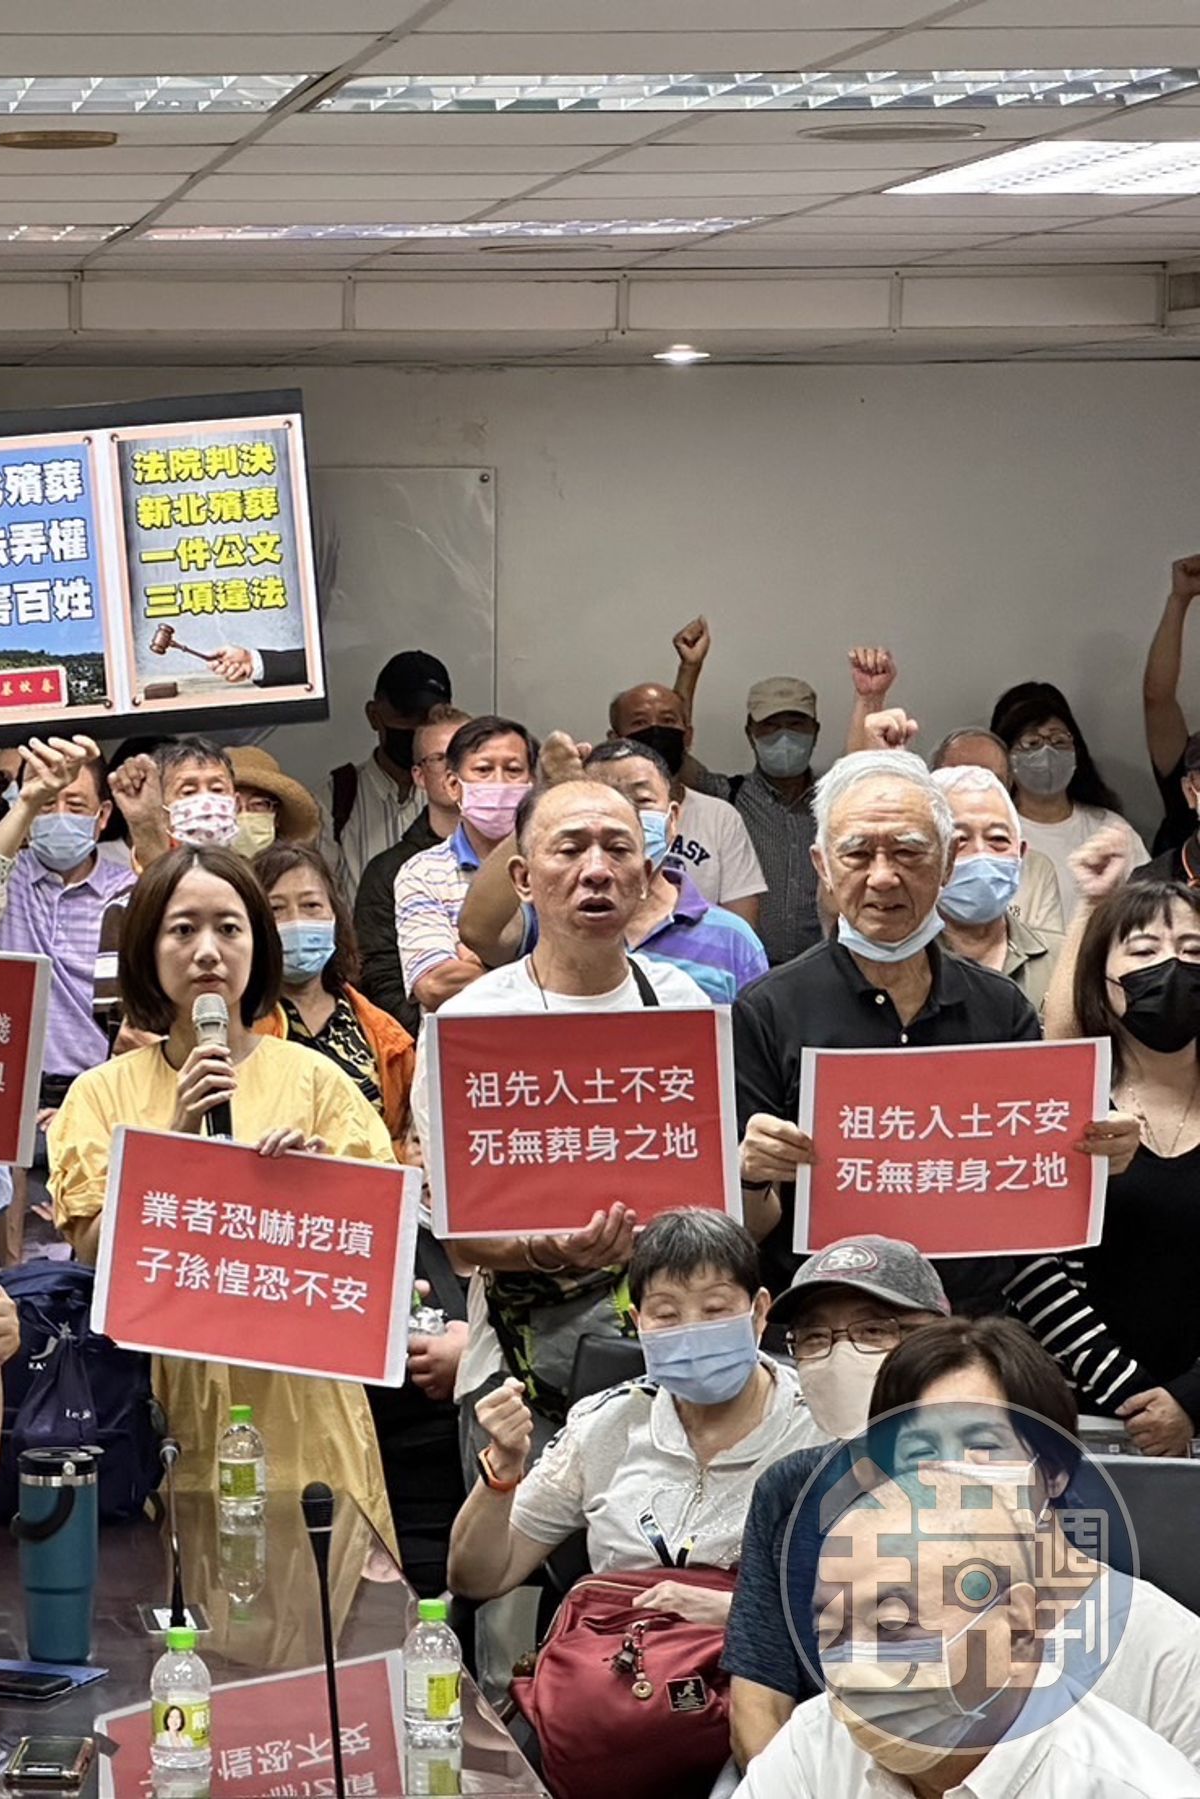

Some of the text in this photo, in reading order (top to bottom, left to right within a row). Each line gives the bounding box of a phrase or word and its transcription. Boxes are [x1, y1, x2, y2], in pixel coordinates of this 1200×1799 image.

[133, 442, 277, 485] 法院判決
[135, 487, 282, 529] 新北殯葬
[140, 531, 285, 573] 一件公文
[143, 576, 291, 619] 三項違法
[465, 1064, 696, 1109] 祖先入土不安
[838, 1097, 1071, 1140] 祖先入土不安
[468, 1122, 698, 1167] 死無葬身之地
[835, 1151, 1069, 1194] 死無葬身之地
[141, 1190, 374, 1259] 業者恐嚇挖墳
[135, 1246, 368, 1315] 子孫惶恐不安
